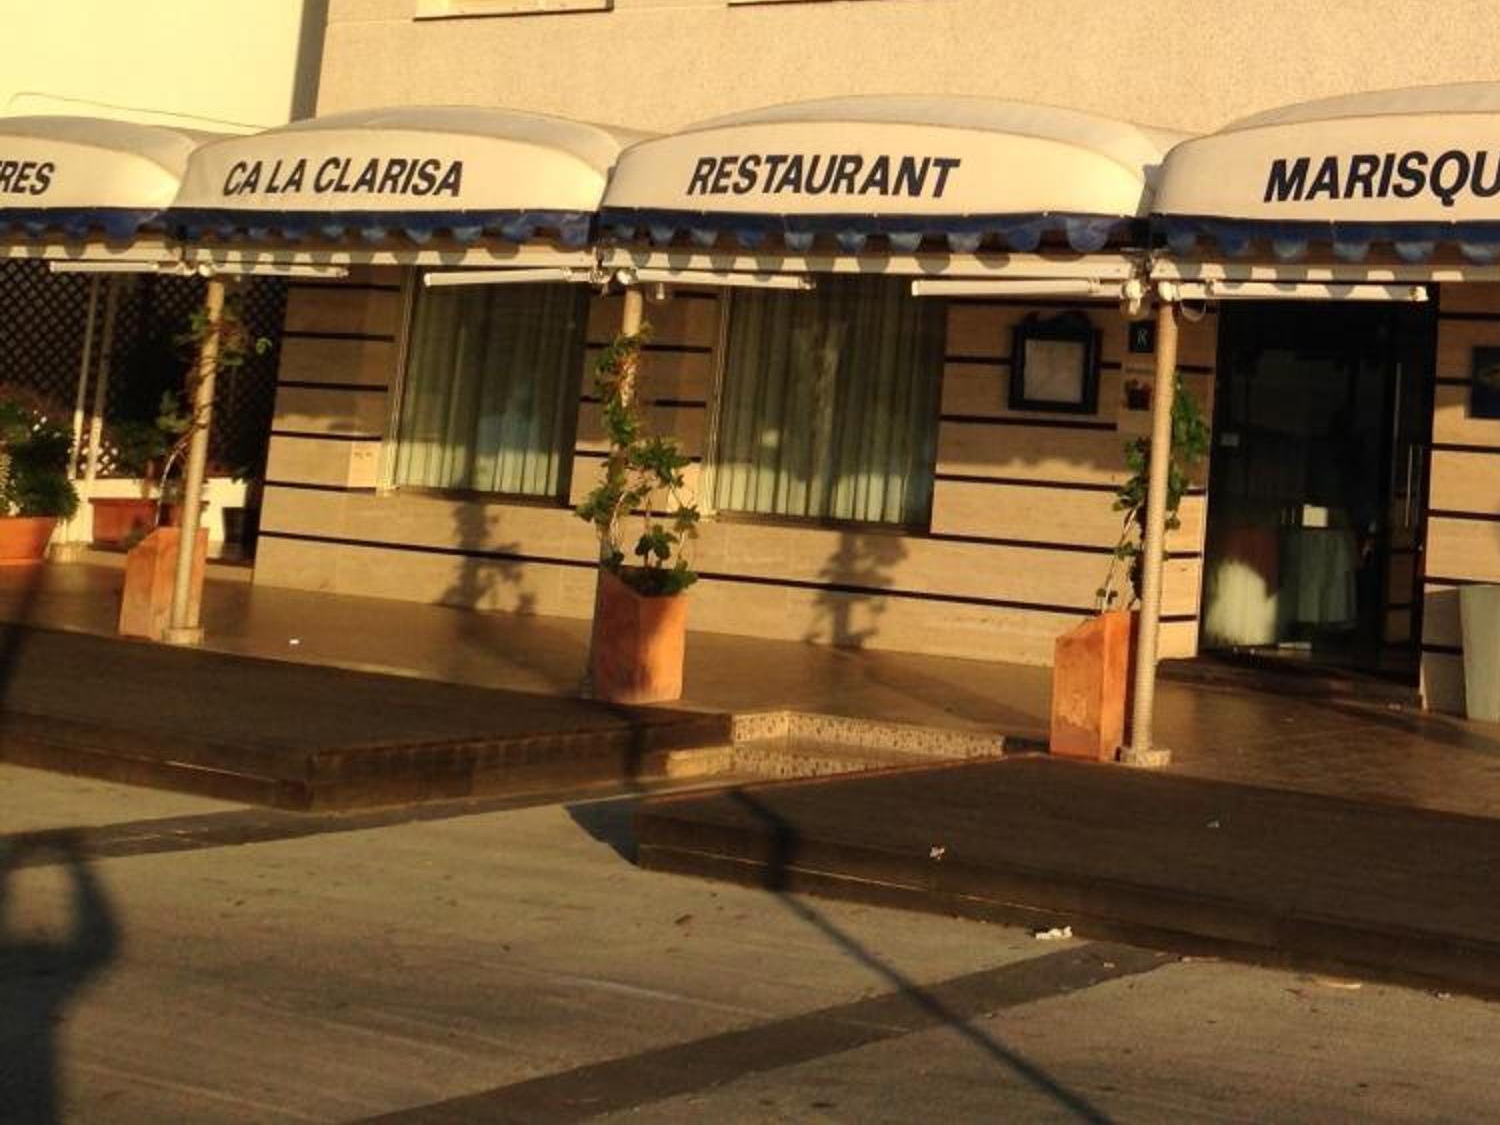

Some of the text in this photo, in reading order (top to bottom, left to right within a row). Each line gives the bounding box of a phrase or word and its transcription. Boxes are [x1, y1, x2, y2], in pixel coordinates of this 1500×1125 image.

[0, 160, 55, 195] RES
[223, 157, 463, 197] CA LA CLARISA
[686, 154, 961, 198] RESTAURANT
